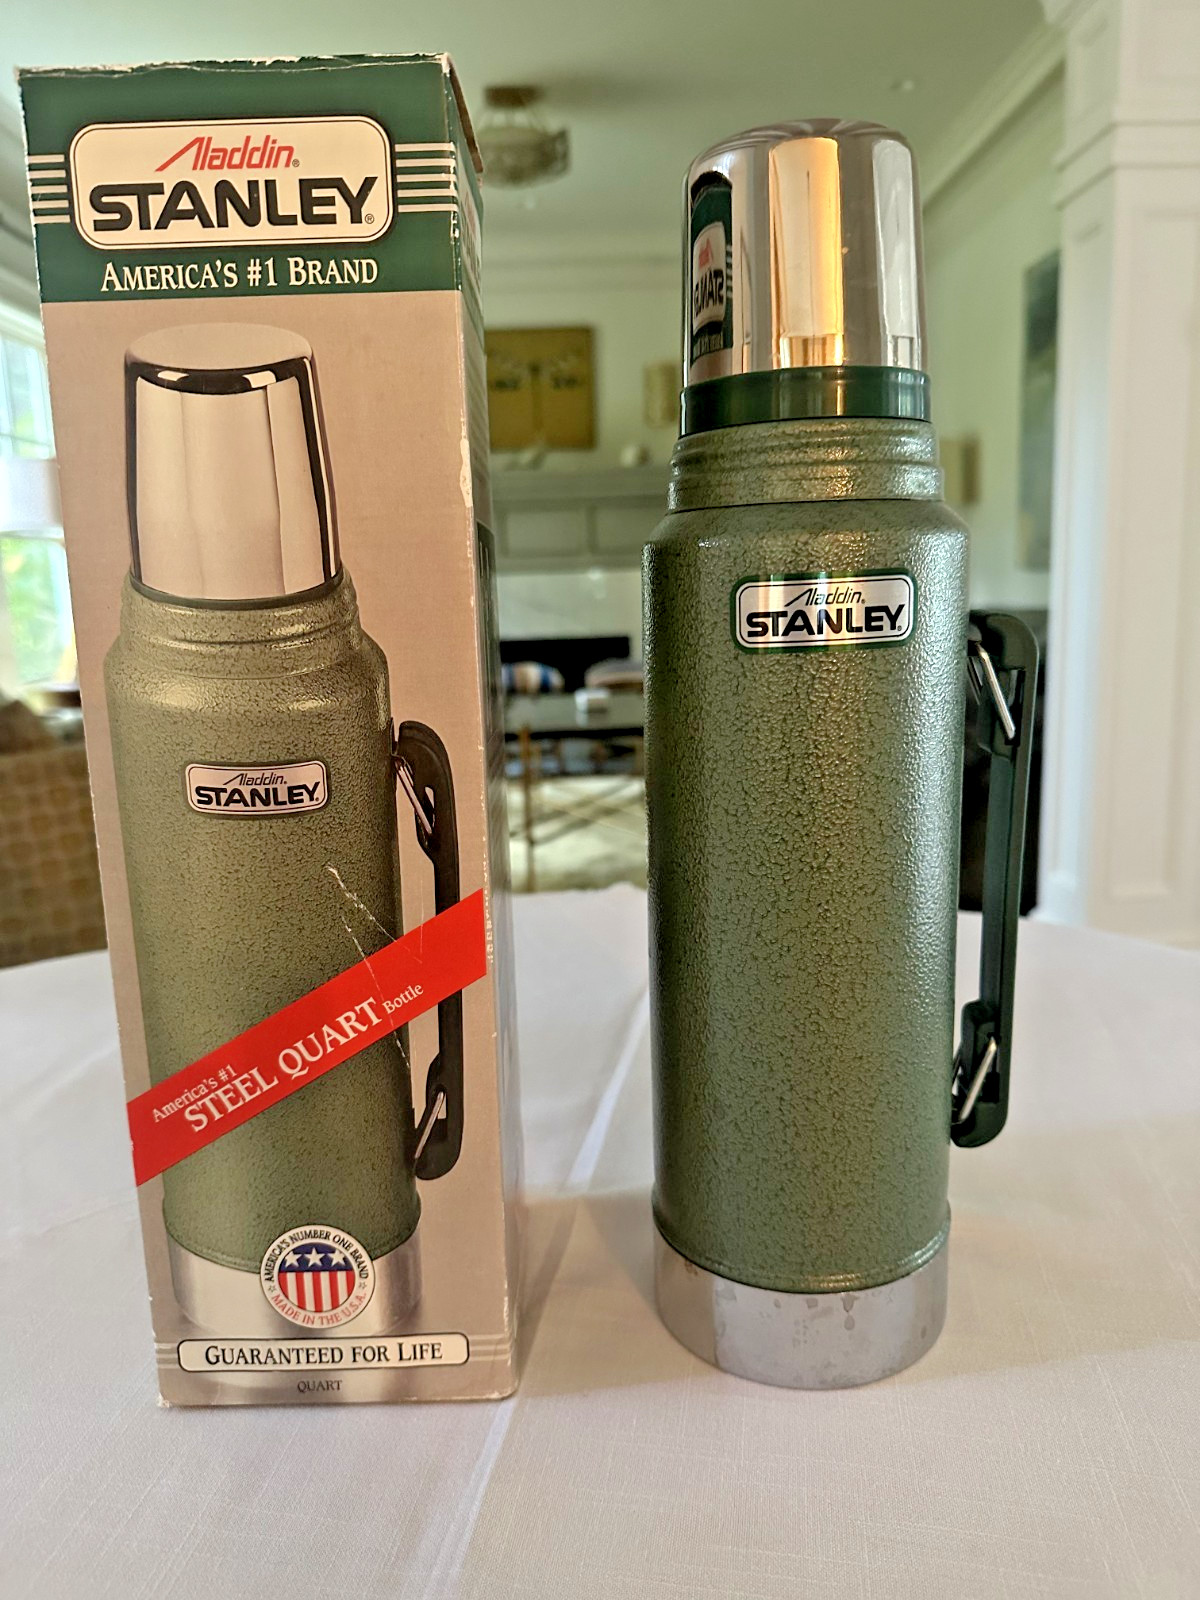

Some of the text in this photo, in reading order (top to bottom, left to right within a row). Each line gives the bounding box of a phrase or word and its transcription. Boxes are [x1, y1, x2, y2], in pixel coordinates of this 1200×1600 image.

[89, 176, 379, 232] STANLEY
[101, 257, 379, 292] AMERICA'S #1 BRAND
[746, 604, 906, 638] STANLEY
[195, 781, 321, 808] STANLEY
[183, 982, 425, 1132] STEEL QUART Bottle
[152, 1064, 239, 1123] America's #1
[289, 1229, 332, 1245] NUMBER
[332, 1234, 354, 1253] ONE
[350, 1248, 369, 1280] BRAND
[271, 1294, 302, 1321] MADE
[302, 1316, 316, 1326] IN
[319, 1312, 343, 1326] THE
[205, 1341, 444, 1366] GUARANTEED FOR LIFE
[297, 1380, 344, 1393] QUART
